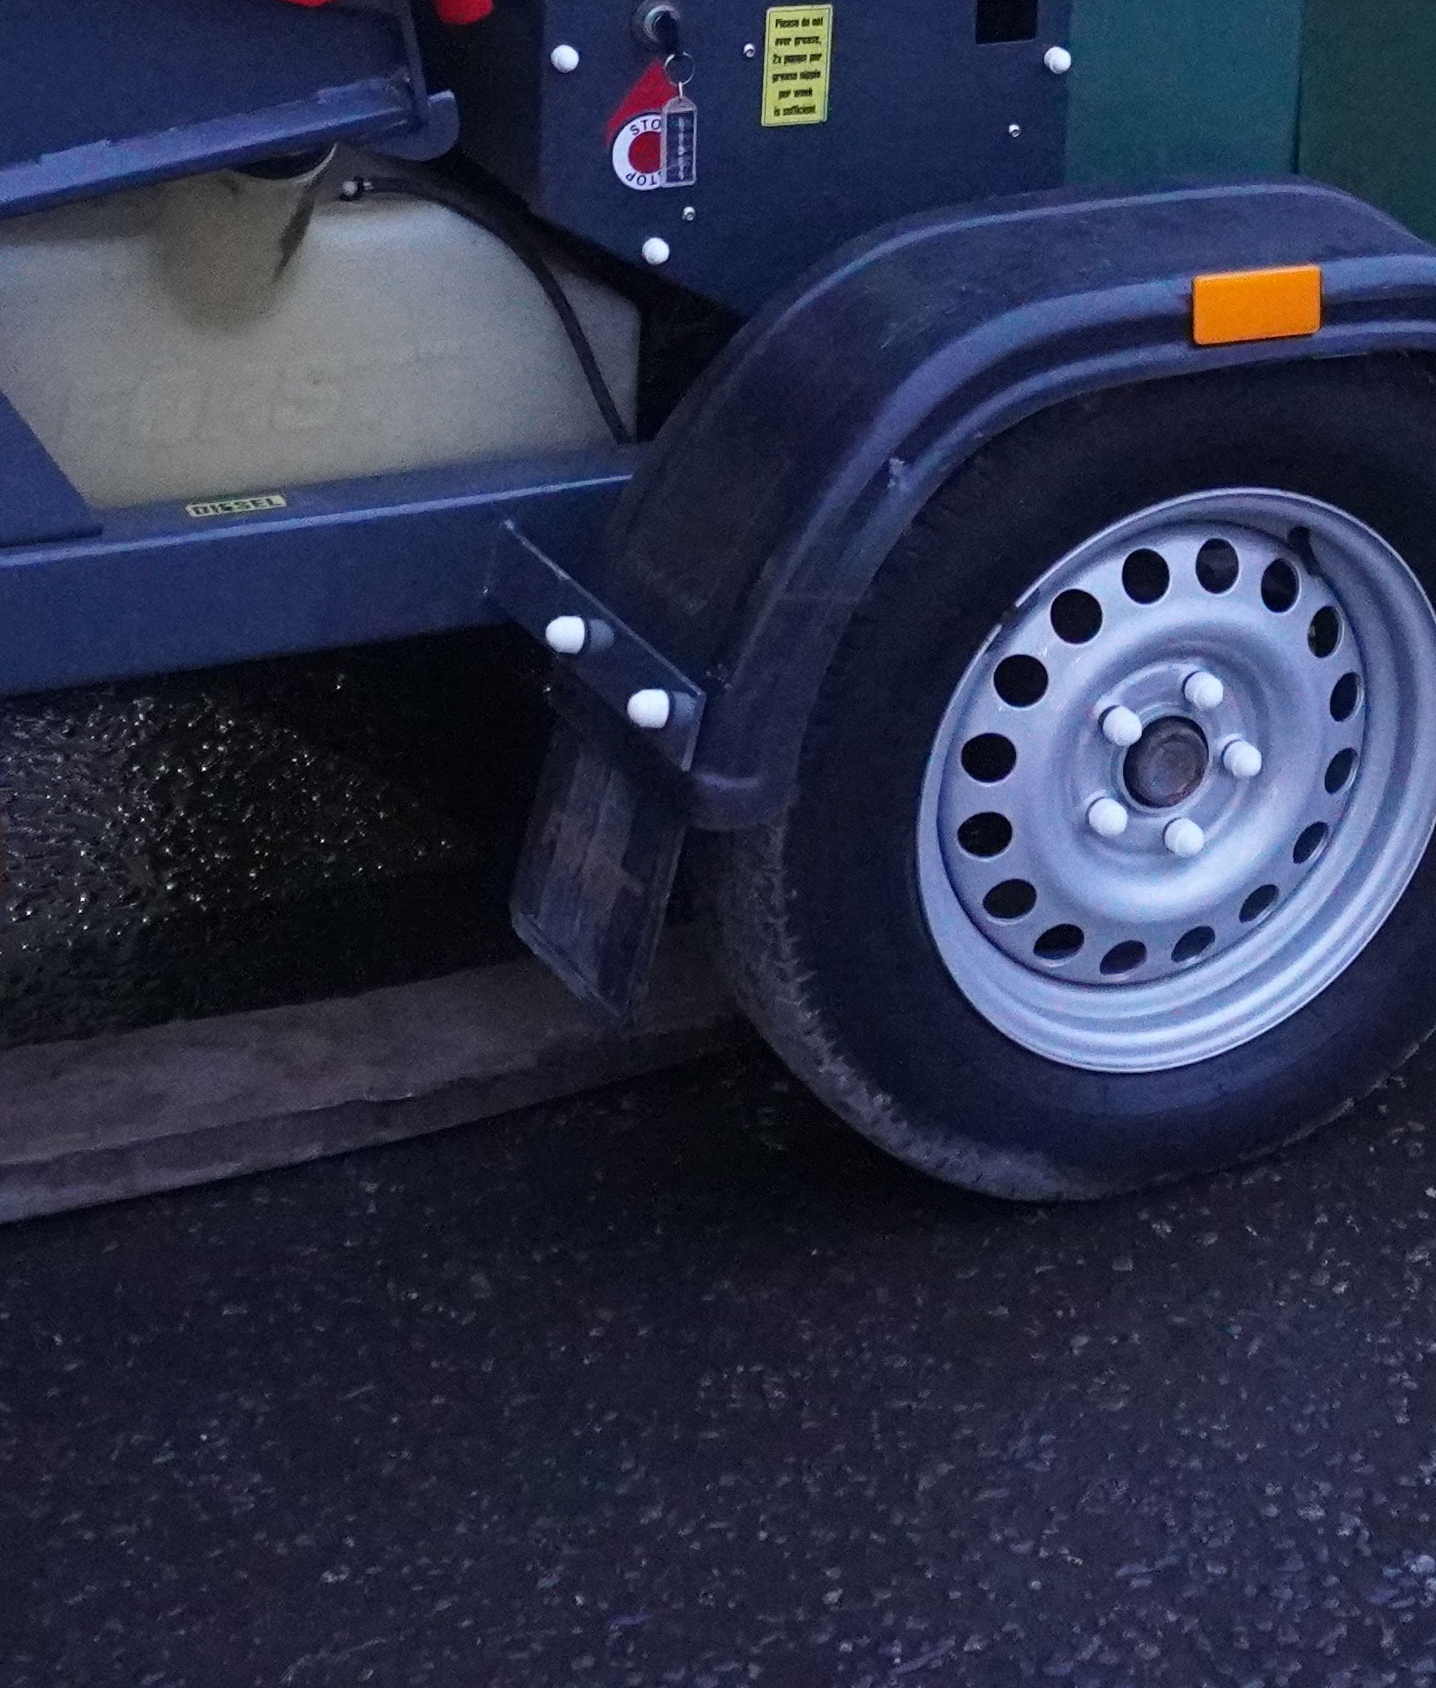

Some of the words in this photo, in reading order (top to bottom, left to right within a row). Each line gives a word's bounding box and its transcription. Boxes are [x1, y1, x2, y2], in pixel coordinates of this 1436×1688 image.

[630, 119, 661, 135] STO
[625, 172, 661, 186] TOP
[192, 498, 282, 515] DIESEL
